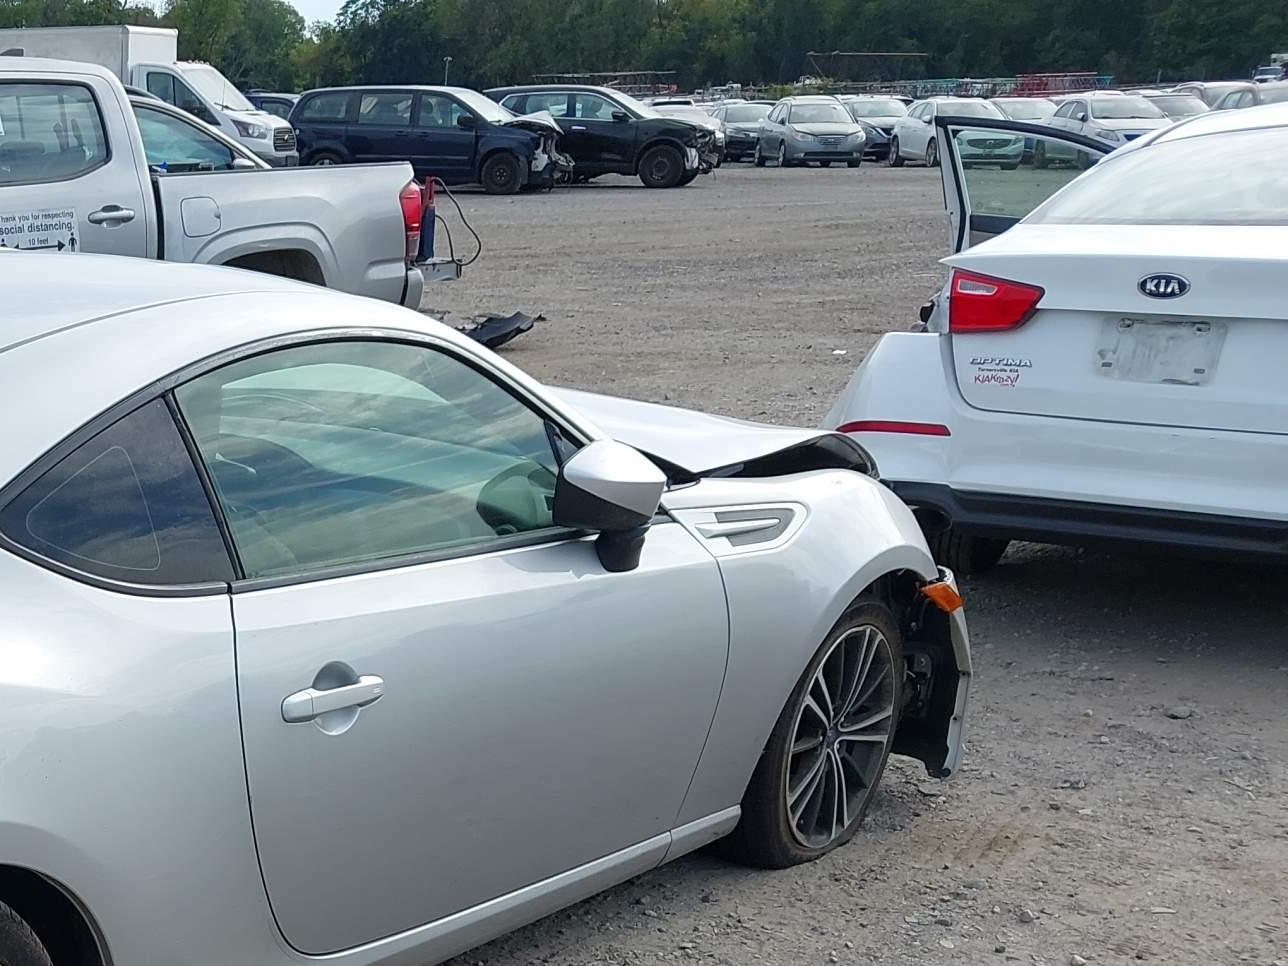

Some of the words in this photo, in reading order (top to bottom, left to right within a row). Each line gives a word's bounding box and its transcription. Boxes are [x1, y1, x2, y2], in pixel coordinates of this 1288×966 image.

[18, 215, 30, 224] you
[32, 212, 40, 220] for
[41, 210, 74, 220] respecting
[0, 224, 25, 235] social
[27, 220, 75, 232] distancing.
[28, 238, 36, 246] 10
[37, 237, 49, 245] feet
[1146, 279, 1180, 294] KIA
[970, 357, 1032, 368] OPTIMA
